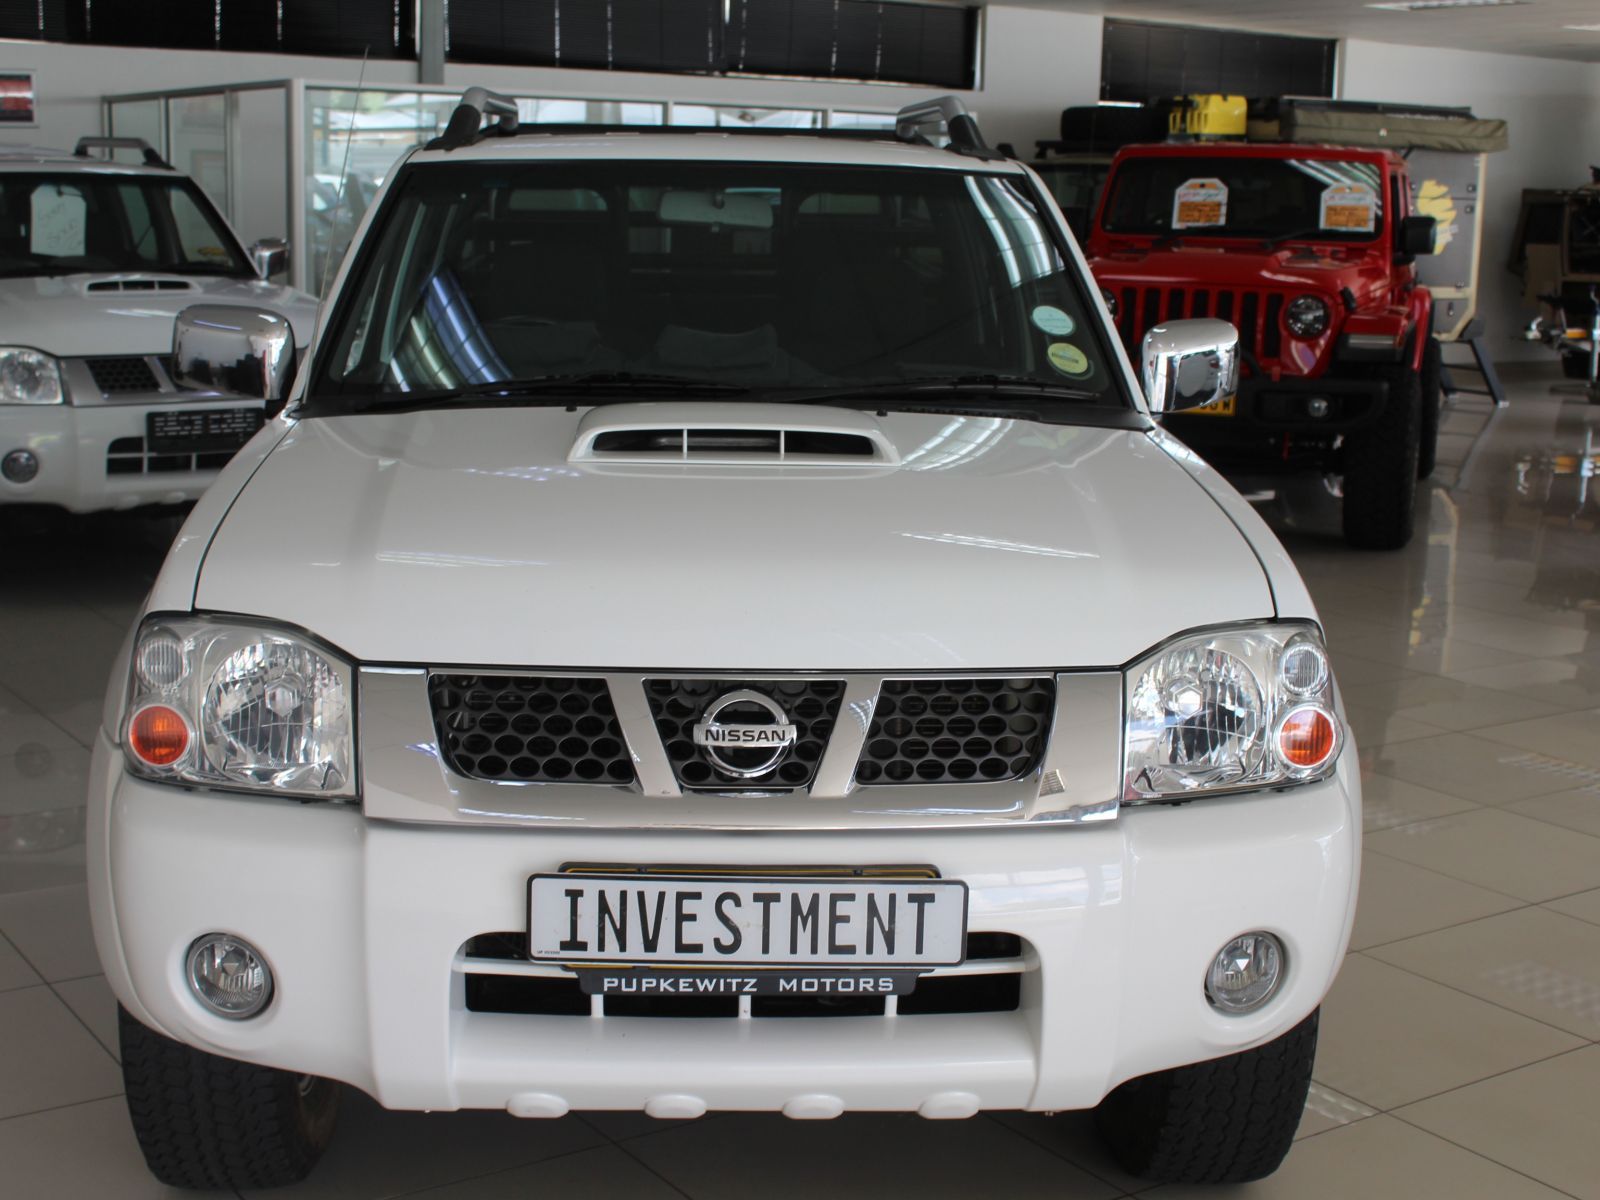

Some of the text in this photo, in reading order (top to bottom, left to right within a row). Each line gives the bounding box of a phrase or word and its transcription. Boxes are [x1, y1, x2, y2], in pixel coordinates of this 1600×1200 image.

[705, 729, 785, 742] NISSAN
[559, 888, 936, 956] INVESTMENT
[602, 977, 895, 993] PUPKEWITZ MOTORS
